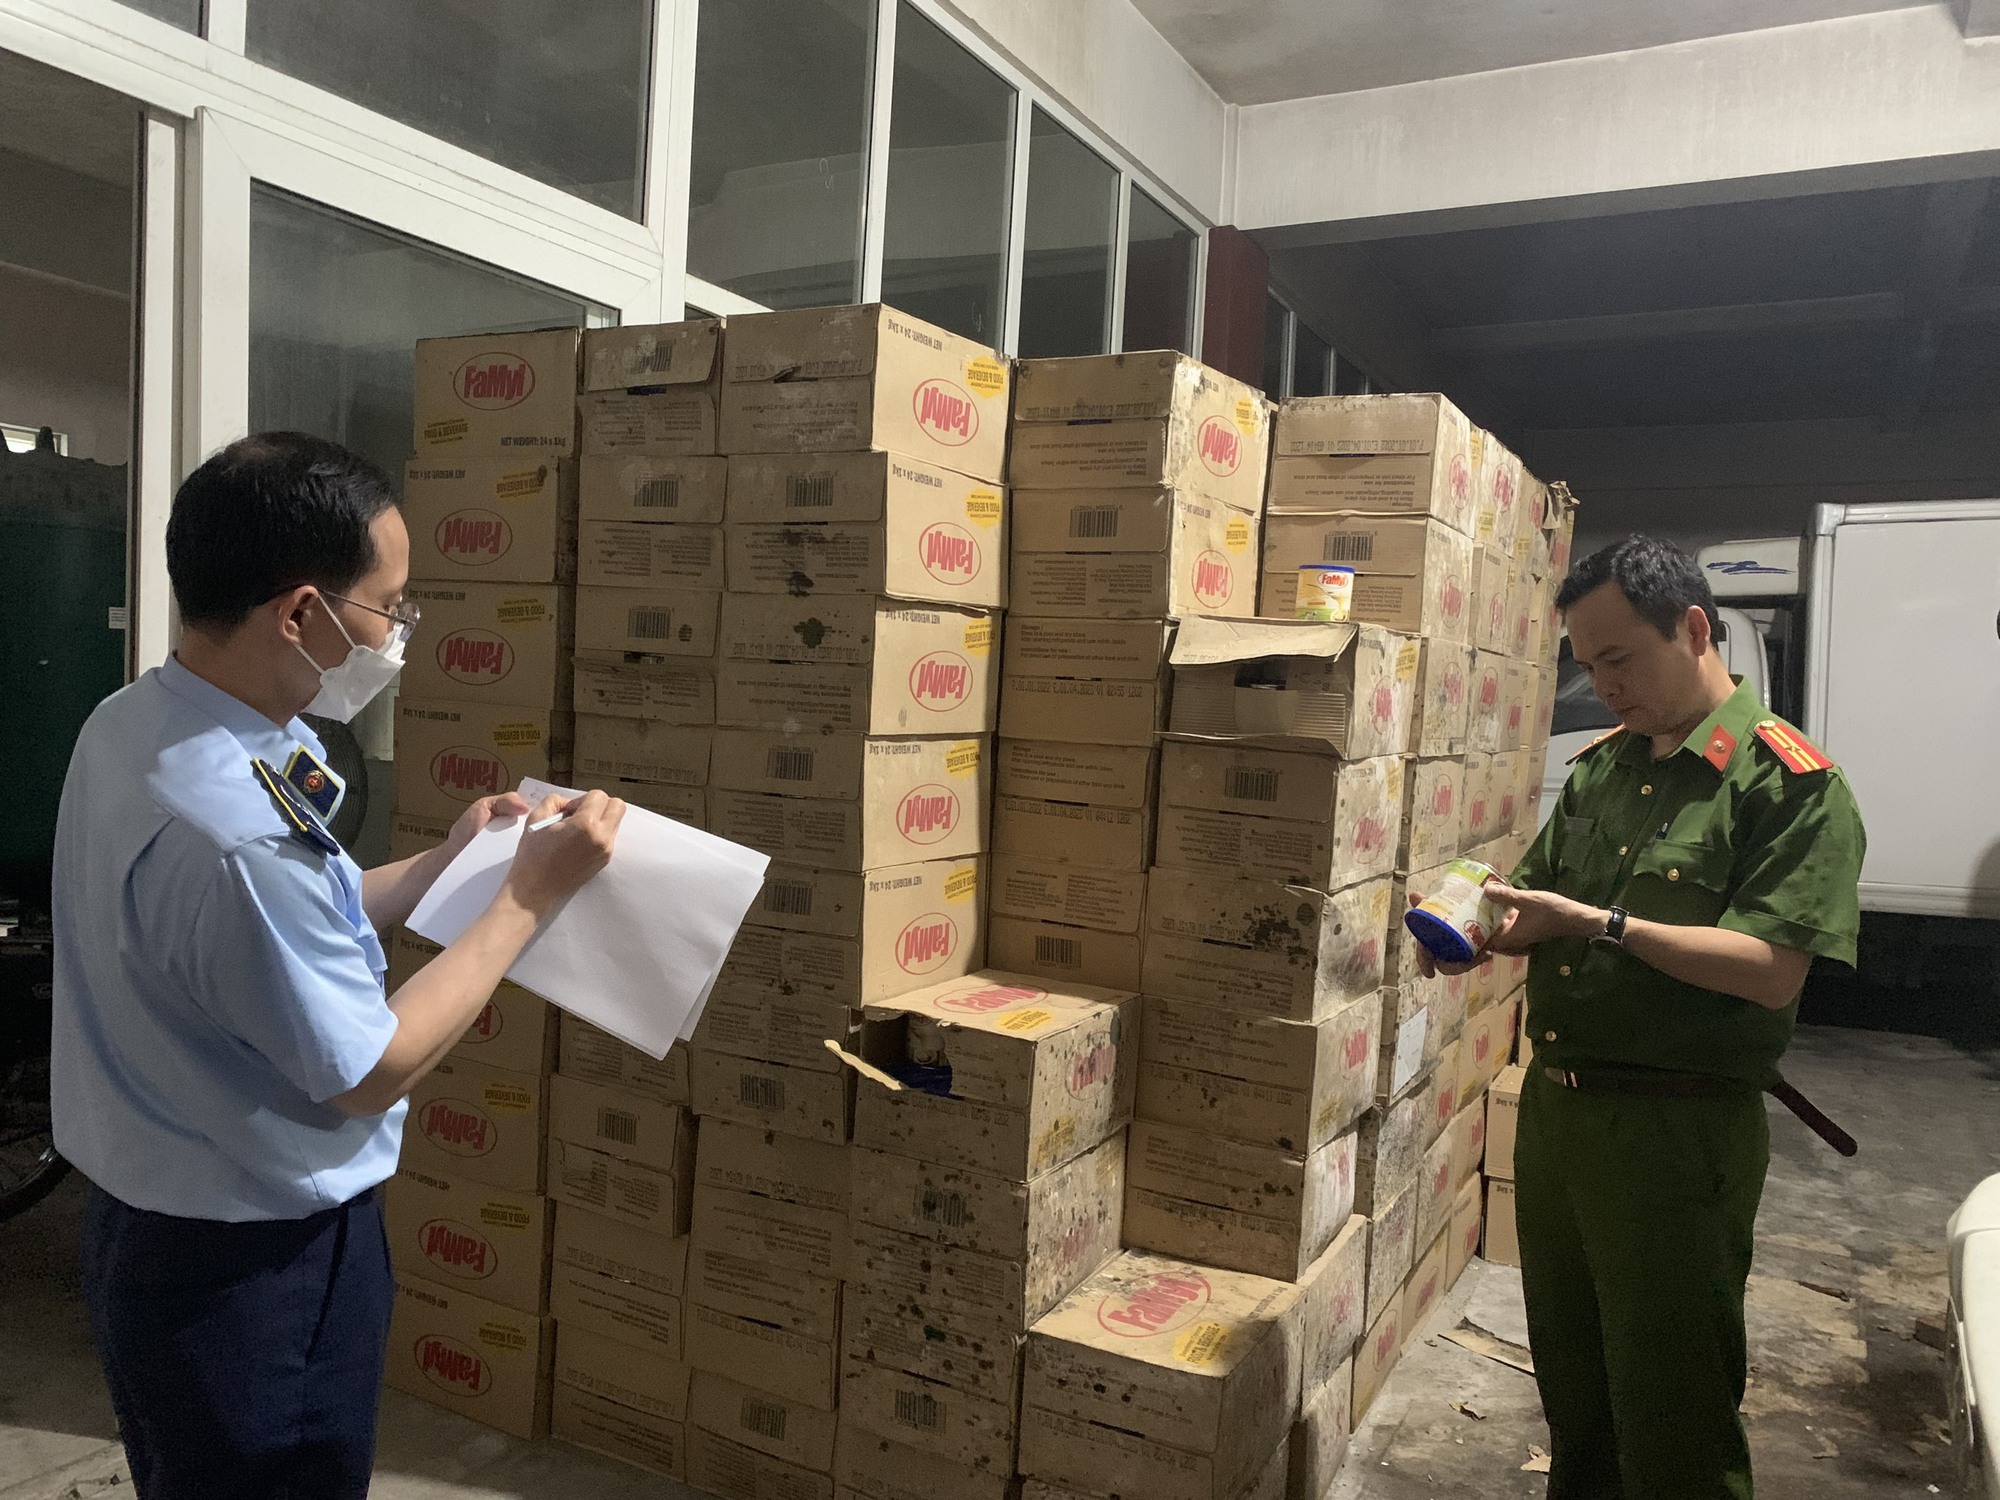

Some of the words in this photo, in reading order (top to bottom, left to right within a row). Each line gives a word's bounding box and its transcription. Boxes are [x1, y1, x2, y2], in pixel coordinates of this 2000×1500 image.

[934, 338, 942, 351] NET
[464, 364, 525, 400] FaMyl
[920, 387, 971, 437] FaMyl
[927, 531, 973, 574] FaMyl
[916, 660, 967, 699] FaMyl
[904, 795, 952, 834] FaMyl
[903, 922, 950, 966] FaMyl
